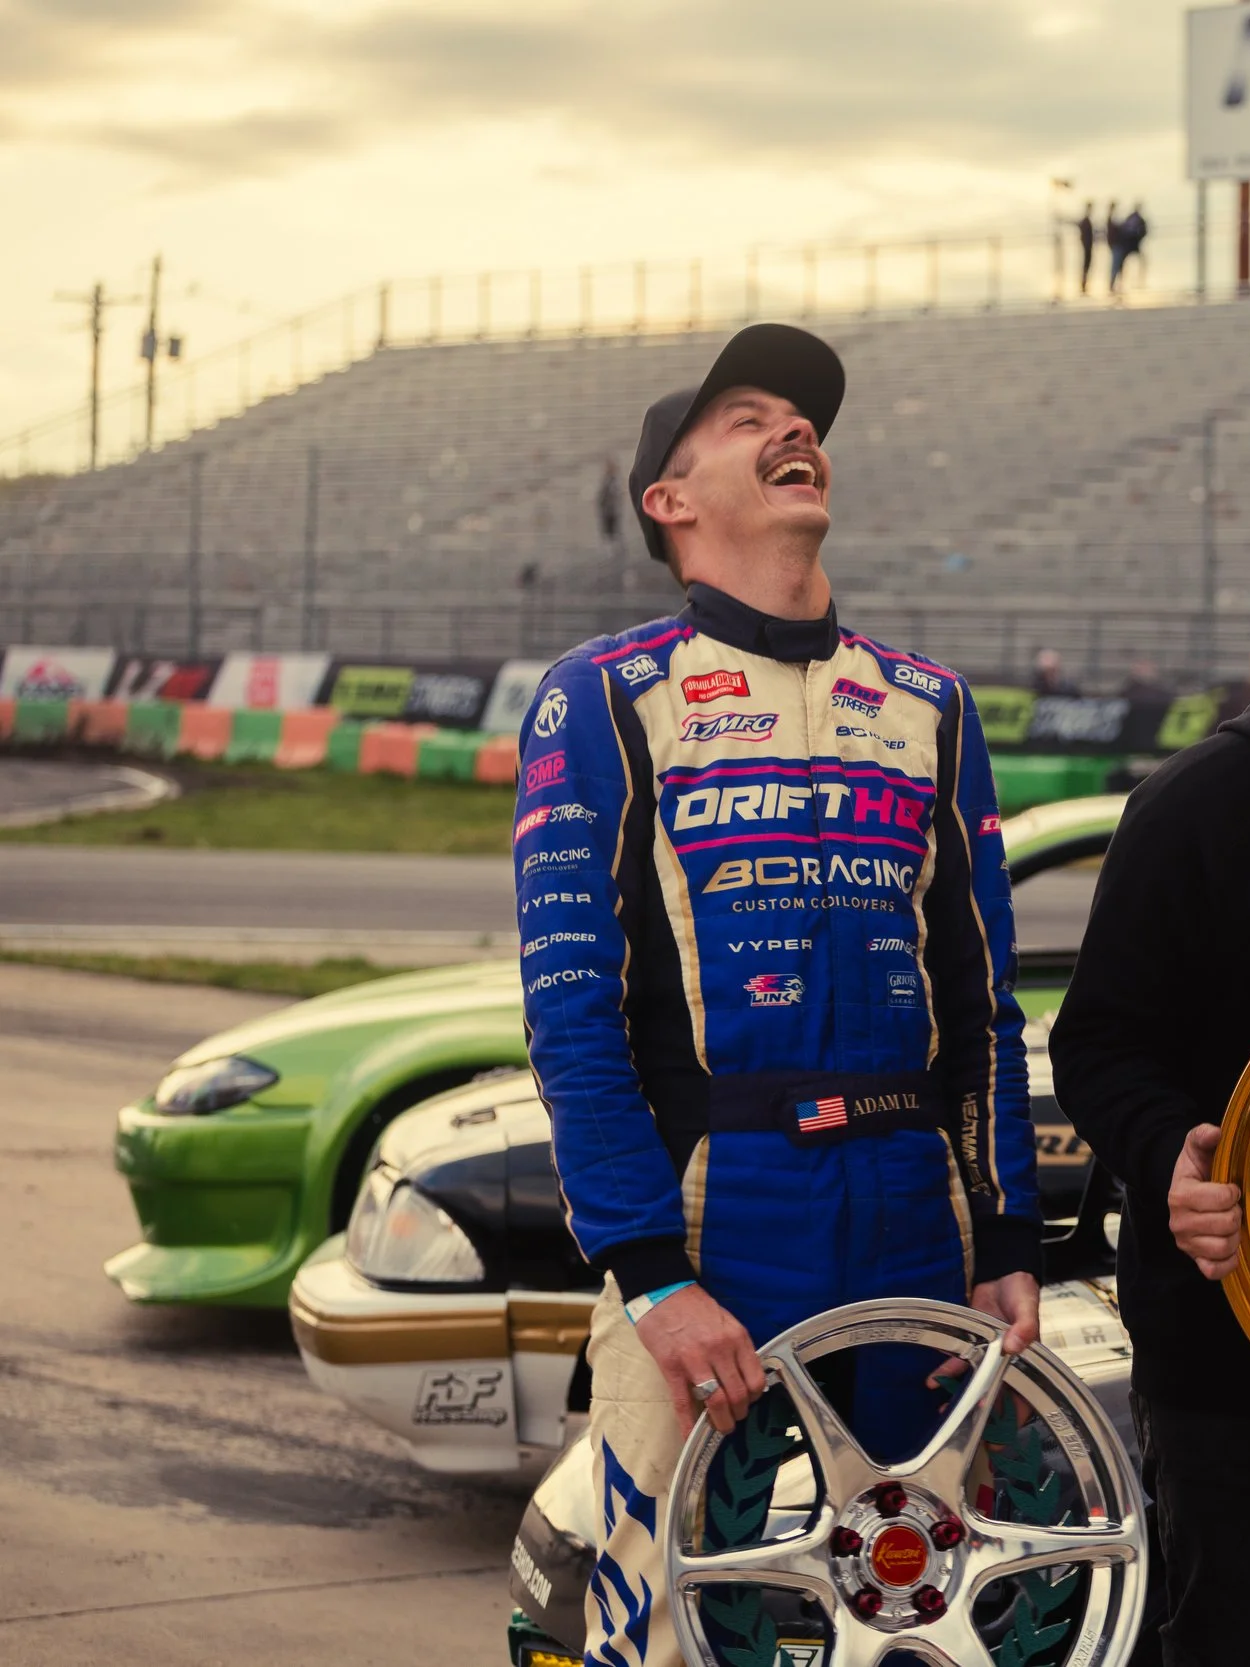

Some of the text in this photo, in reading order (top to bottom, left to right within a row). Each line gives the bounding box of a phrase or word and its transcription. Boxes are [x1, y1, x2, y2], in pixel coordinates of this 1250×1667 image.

[684, 677, 717, 693] FORMULA
[895, 667, 941, 691] OMP
[832, 695, 881, 718] STREETS
[526, 757, 566, 789] OMP
[550, 803, 598, 825] STREETS
[522, 892, 592, 914] VYPER
[733, 895, 895, 912] CUSTOM COILOVERS
[728, 939, 813, 953] VYPER
[752, 992, 791, 1003] LINK
[853, 1094, 900, 1116] ADAM
